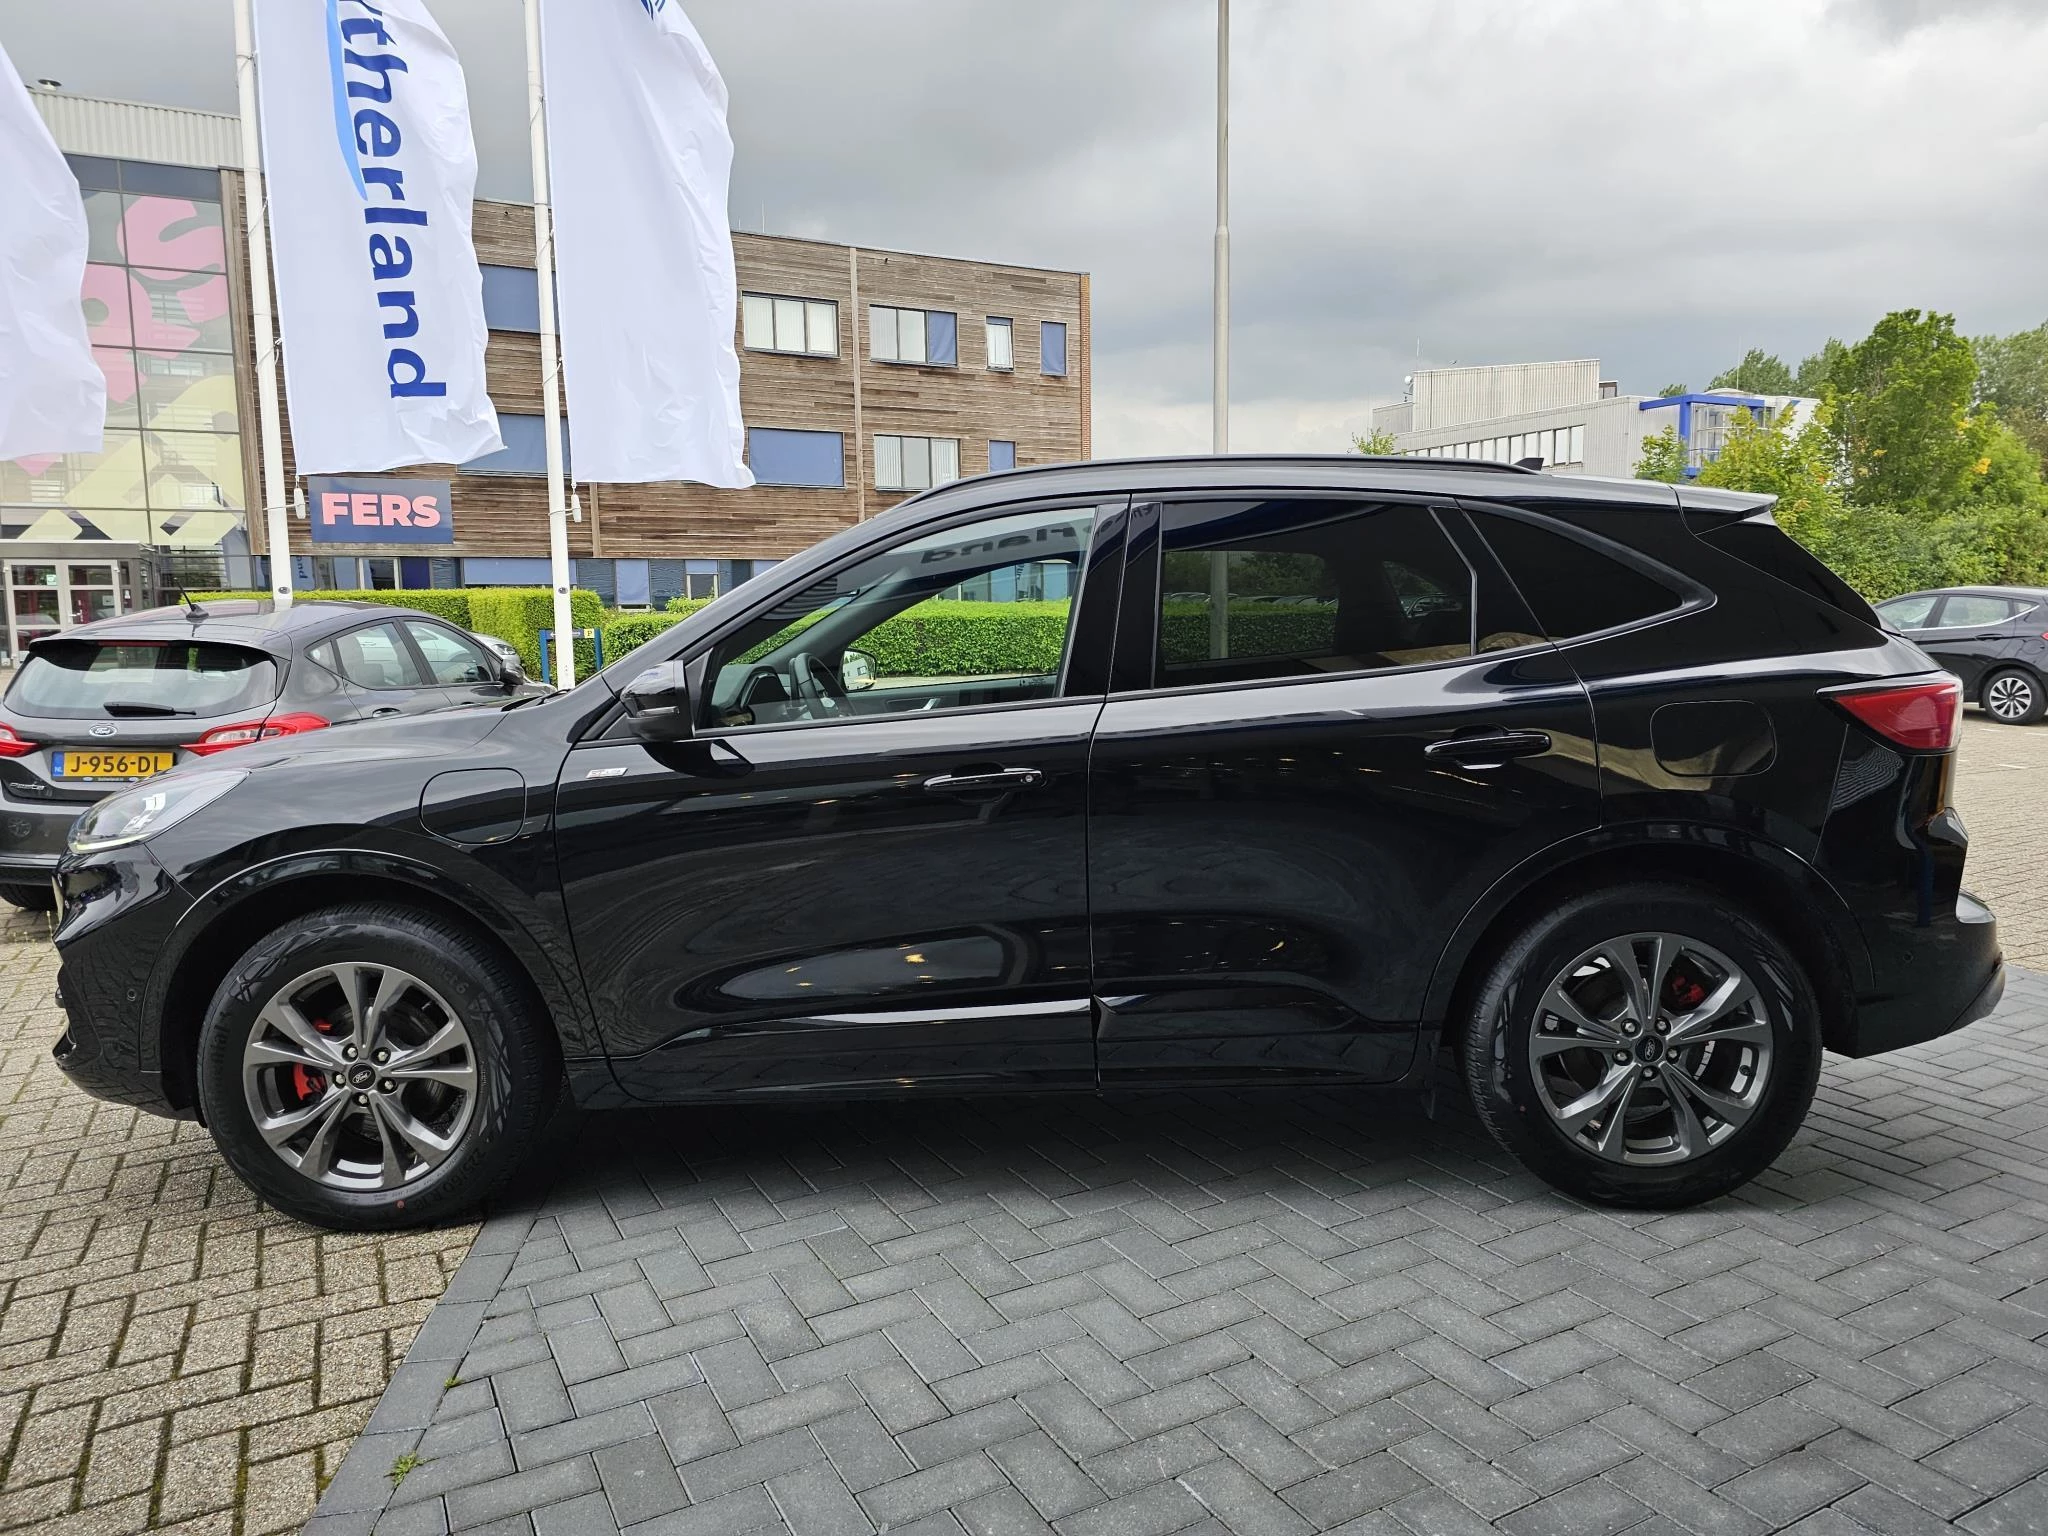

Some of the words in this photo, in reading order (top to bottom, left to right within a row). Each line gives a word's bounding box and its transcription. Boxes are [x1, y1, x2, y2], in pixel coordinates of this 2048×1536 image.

[339, 0, 446, 398] therland
[321, 492, 441, 528] FERS
[71, 755, 162, 773] J-956-DL
